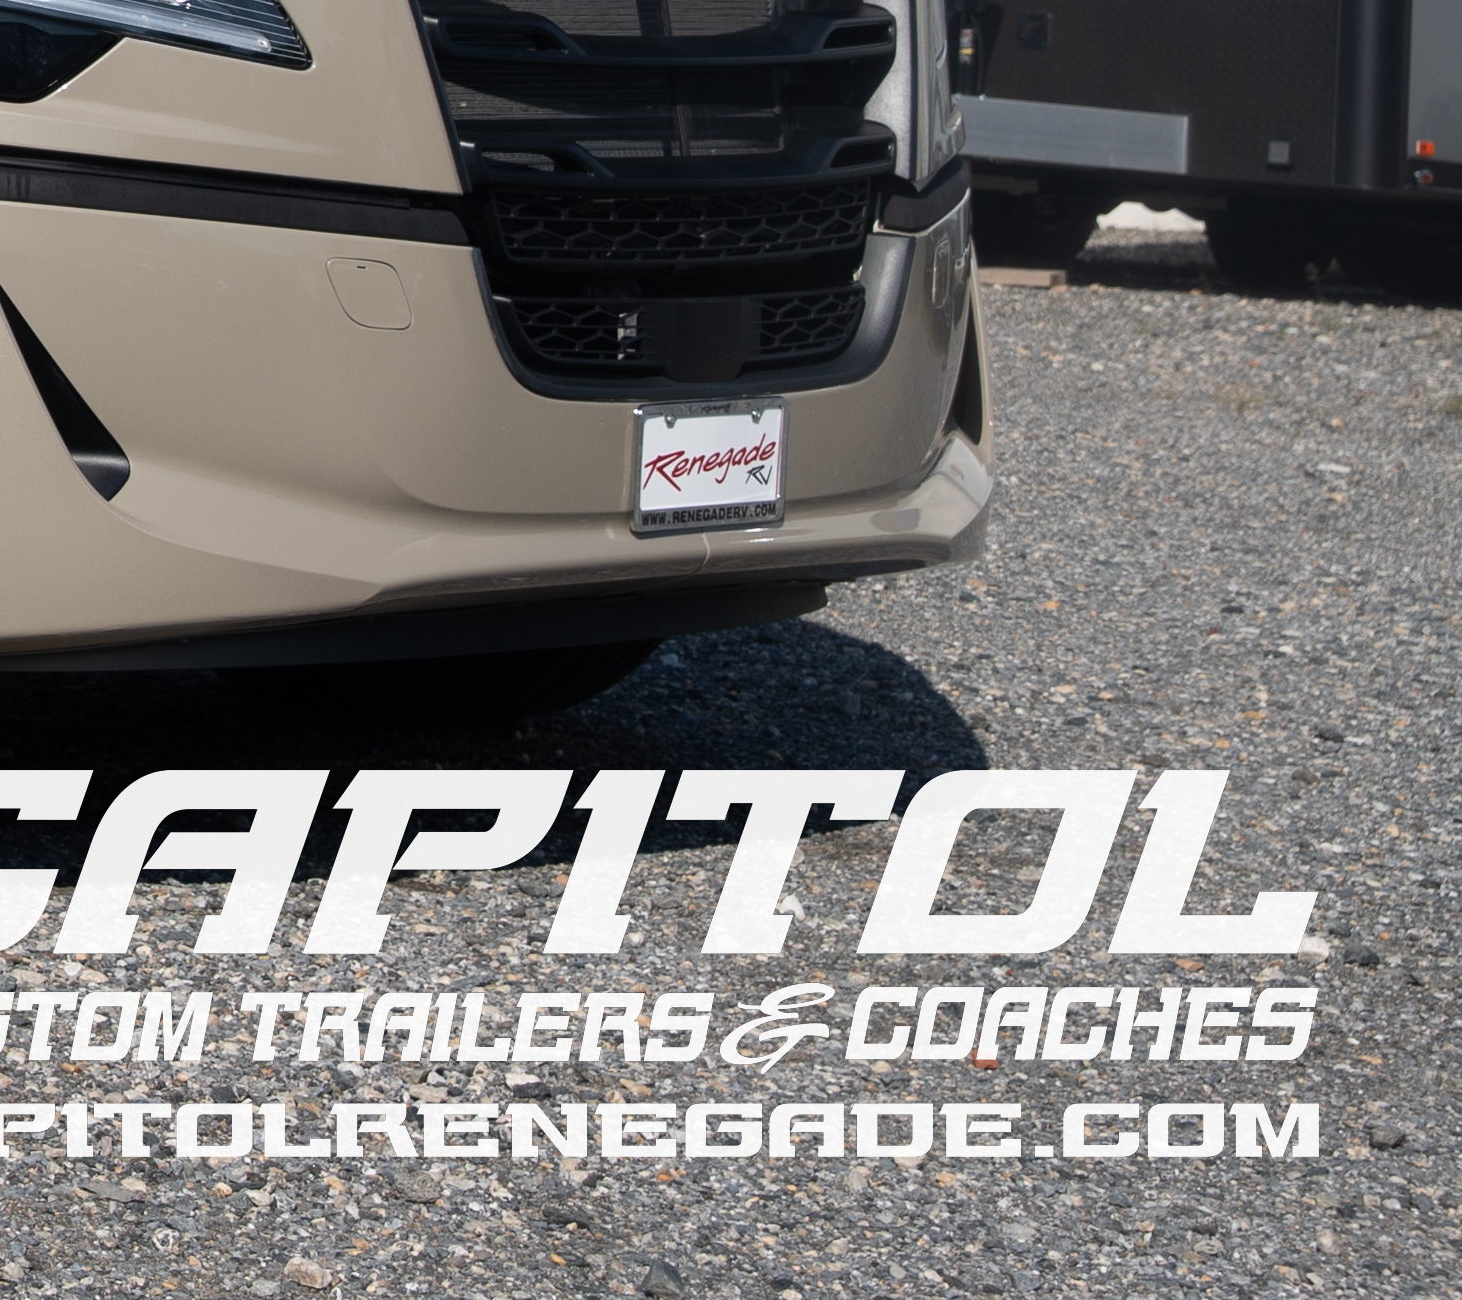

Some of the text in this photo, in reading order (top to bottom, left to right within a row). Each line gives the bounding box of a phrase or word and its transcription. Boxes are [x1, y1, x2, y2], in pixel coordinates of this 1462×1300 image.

[642, 432, 777, 492] Renegade
[745, 464, 774, 486] RV
[641, 502, 777, 527] WWW.RENEGADERV.COM
